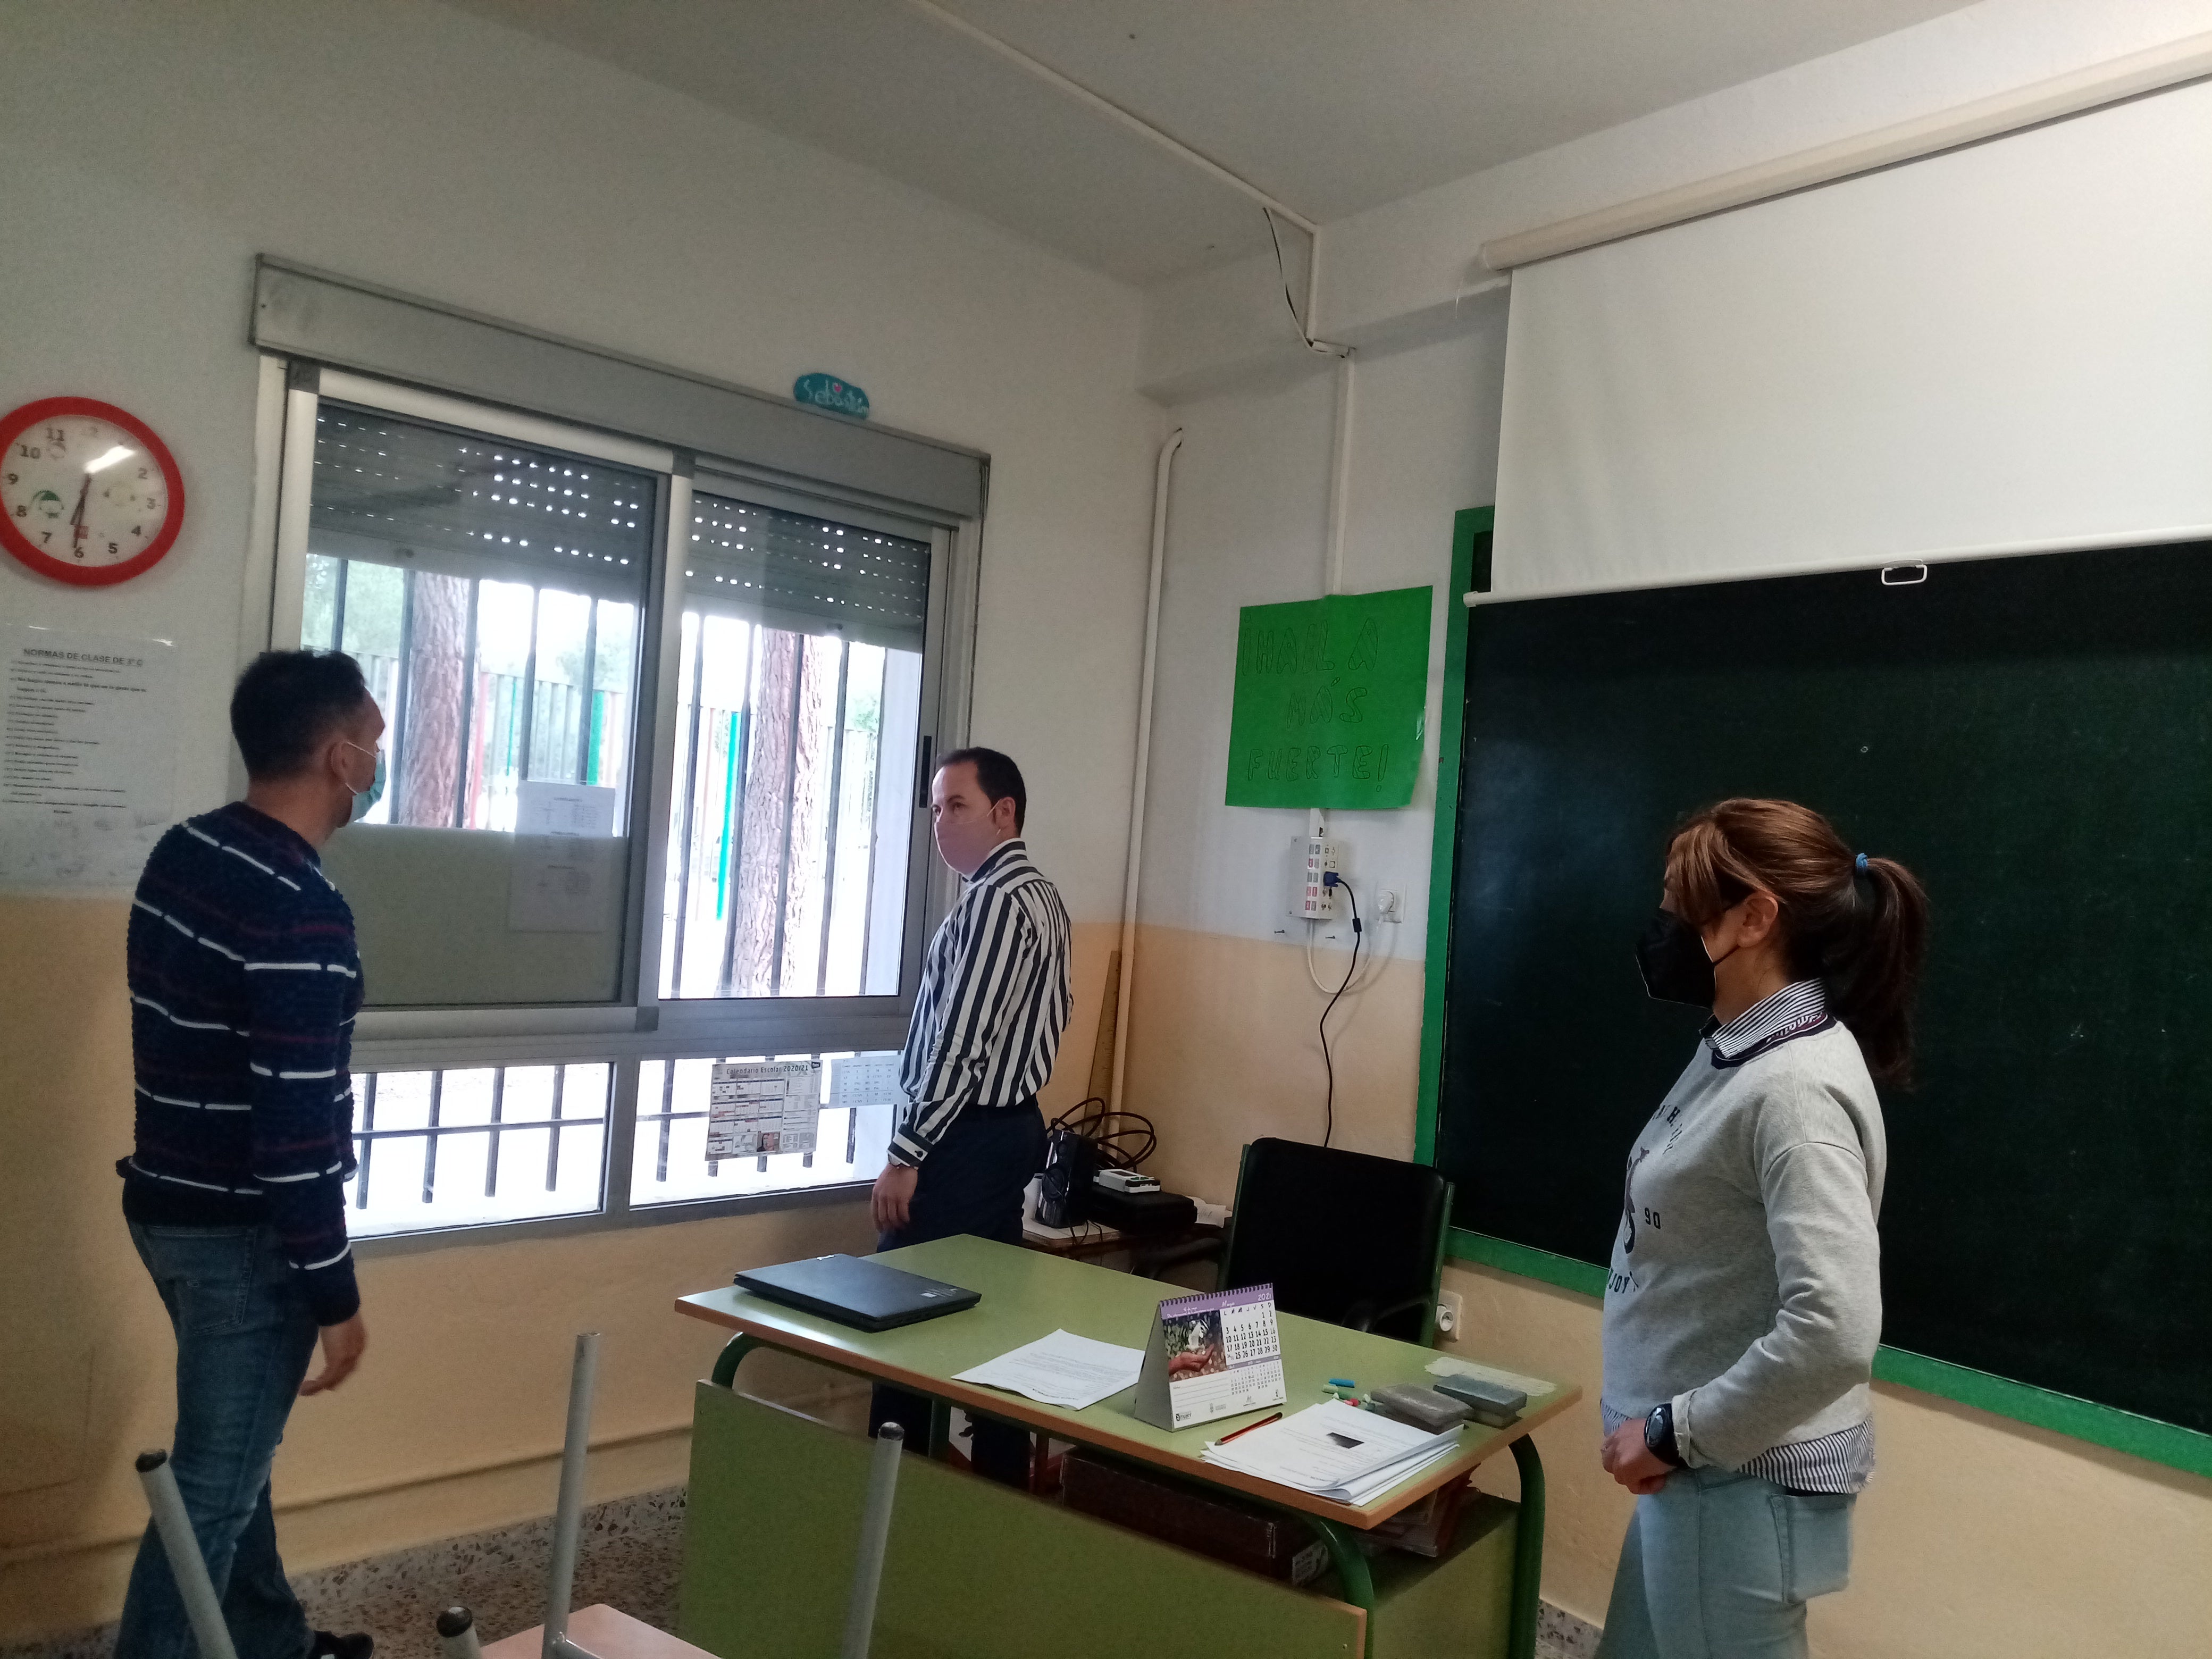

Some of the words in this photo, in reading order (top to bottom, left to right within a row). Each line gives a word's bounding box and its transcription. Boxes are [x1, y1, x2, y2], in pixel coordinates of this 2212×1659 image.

[47, 428, 64, 441] 11
[20, 445, 40, 459] 10
[138, 467, 148, 479] 2
[8, 473, 19, 485] 9
[147, 498, 156, 510] 3
[16, 505, 27, 517] 8
[131, 525, 141, 537] 4
[41, 532, 52, 543] 7
[74, 547, 84, 558] 6
[108, 542, 118, 554] 5
[24, 648, 64, 658] NORMAS
[81, 654, 111, 663] CLASE
[1645, 1208, 1661, 1229] 90
